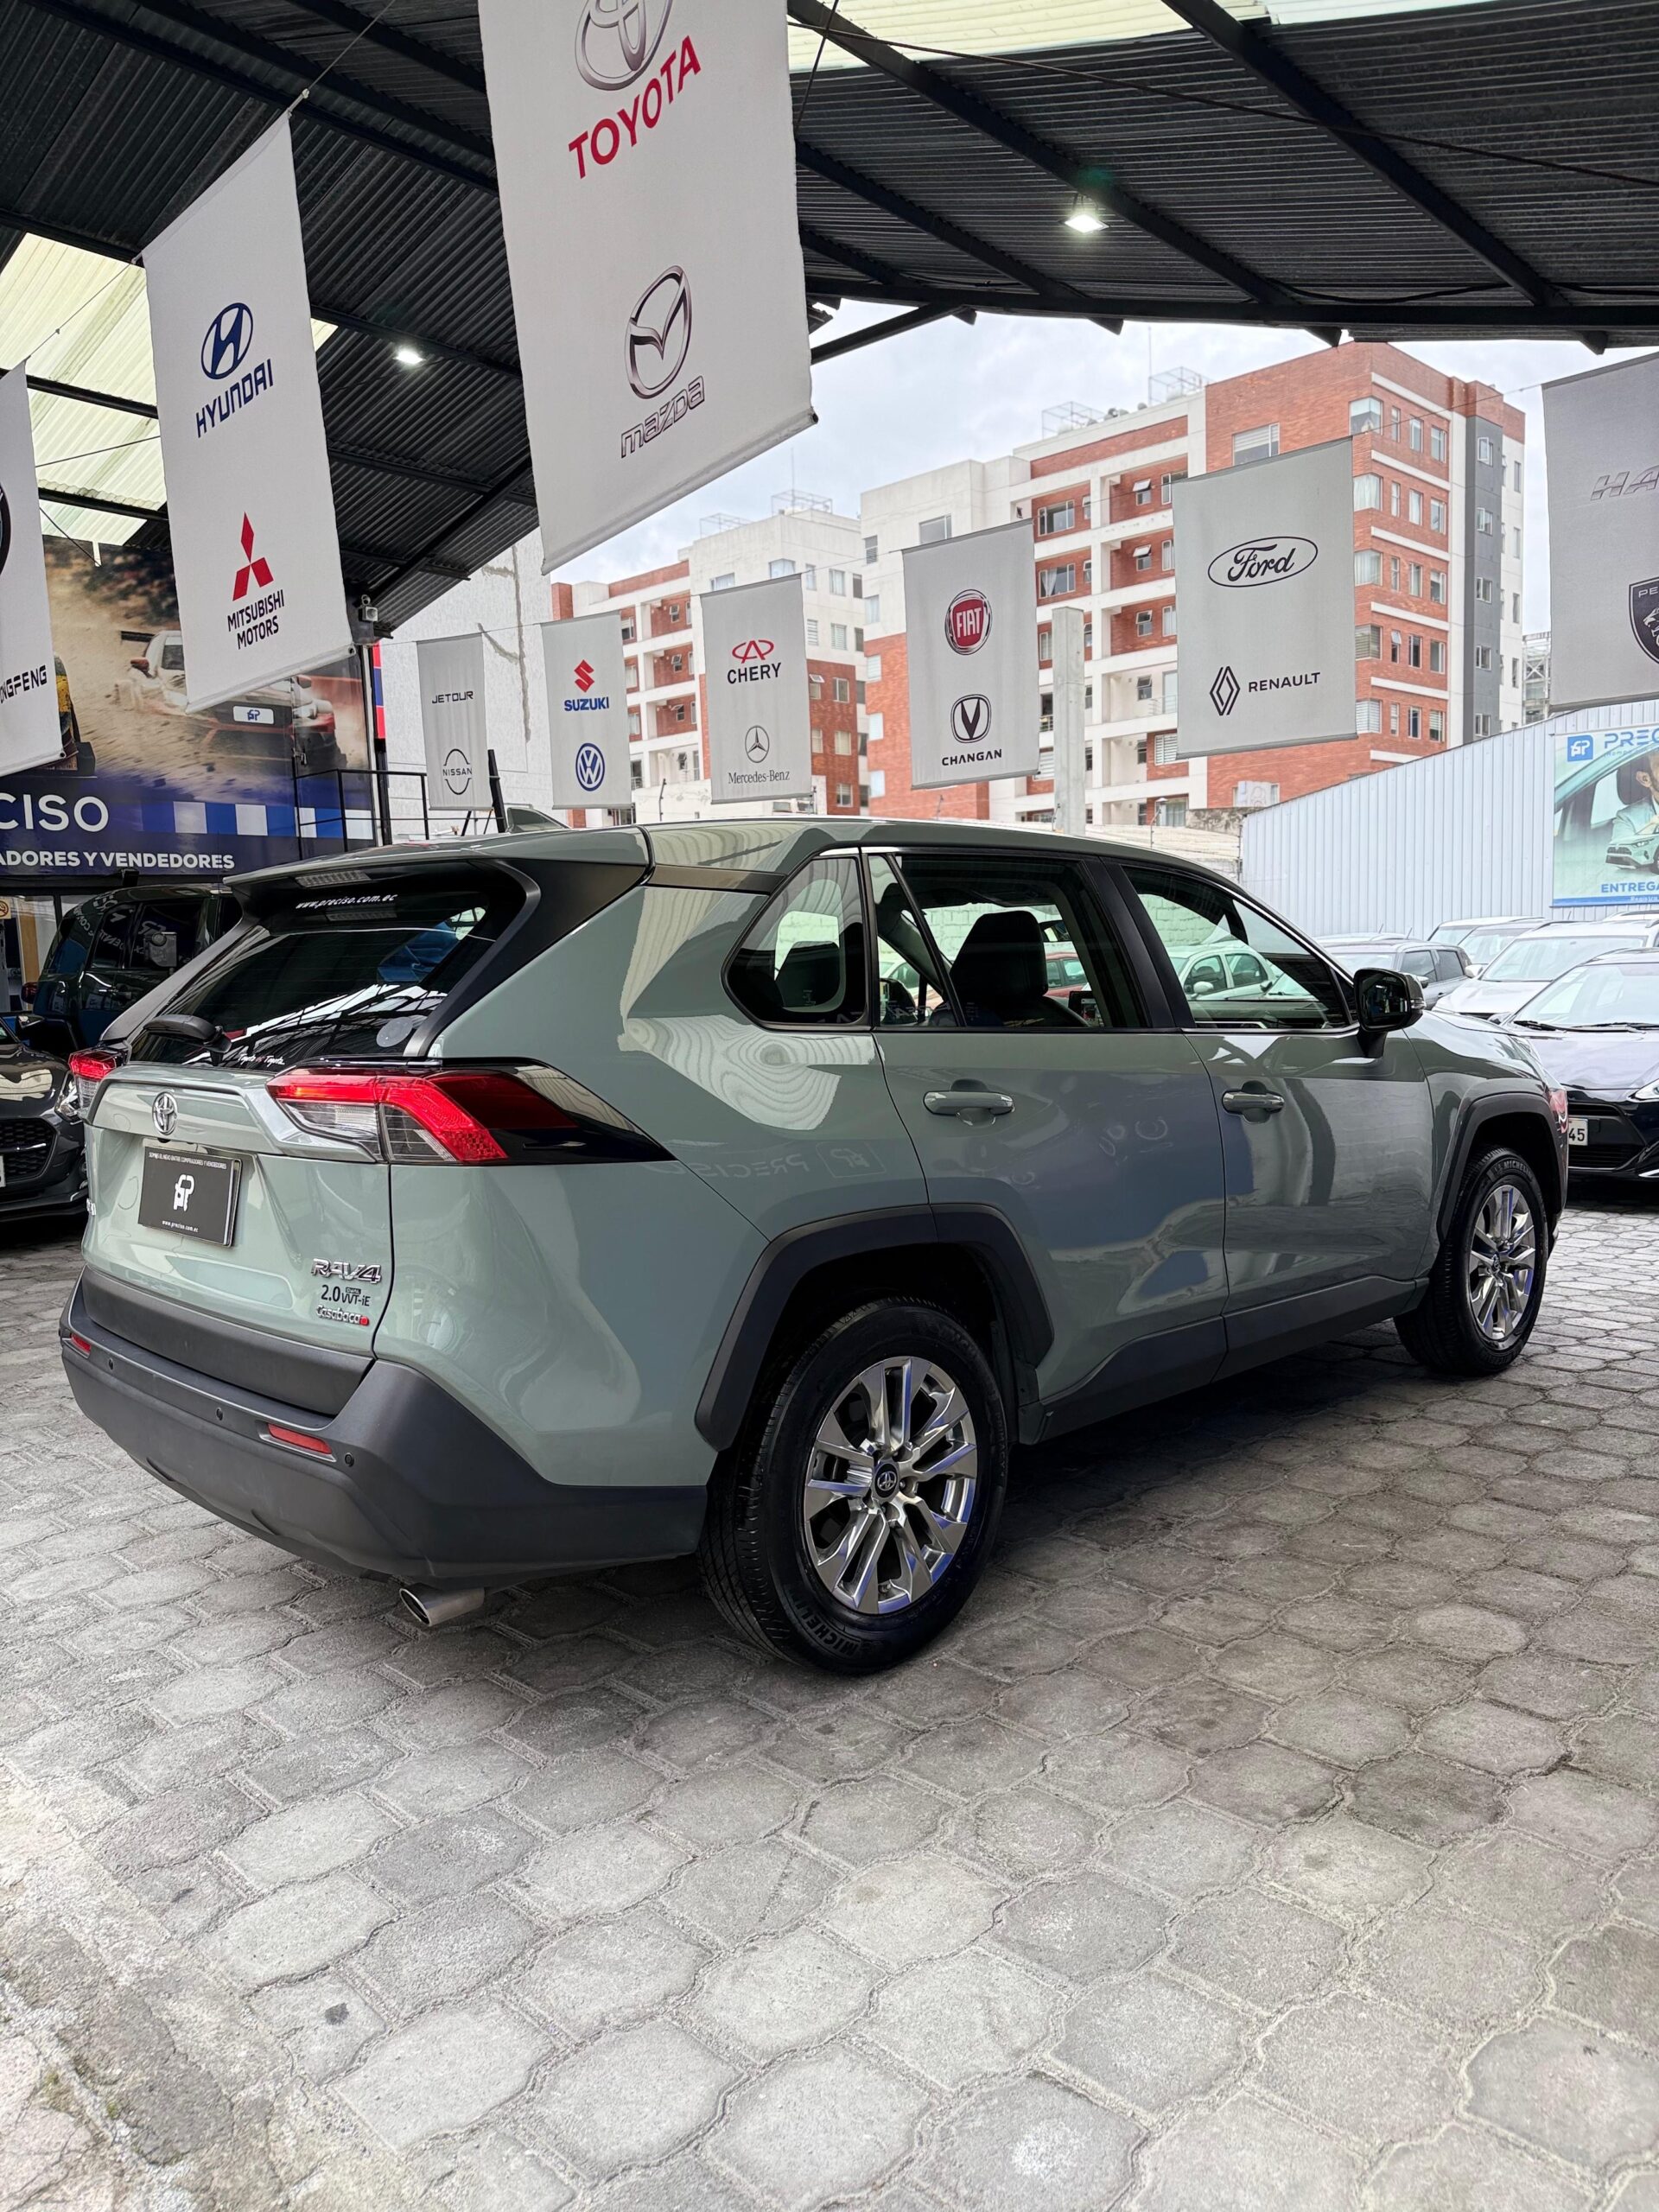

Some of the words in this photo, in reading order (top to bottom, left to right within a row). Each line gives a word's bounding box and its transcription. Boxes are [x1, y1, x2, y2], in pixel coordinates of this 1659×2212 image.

[568, 35, 702, 179] TOYOTA
[195, 359, 274, 438] HYUNDAI
[1227, 543, 1296, 582] Ford
[227, 589, 285, 632] MITSUBISHI
[956, 607, 982, 638] FIAT
[237, 615, 279, 650] MOTORS
[728, 662, 781, 684] CHERY
[1248, 672, 1320, 693] RENAULT
[432, 691, 474, 704] JETOUR
[564, 696, 609, 712] SUZUKI
[942, 749, 1002, 766] CHANGAN
[442, 766, 473, 777] NISSAN
[728, 769, 790, 785] Mercedes-Benz
[83, 852, 98, 867] Y
[100, 852, 235, 869] VENDEDORES
[296, 894, 397, 909] www.preciso.com.ec
[1569, 1128, 1585, 1141] 45
[311, 1258, 382, 1284] RAV4
[321, 1284, 340, 1302] 2.0
